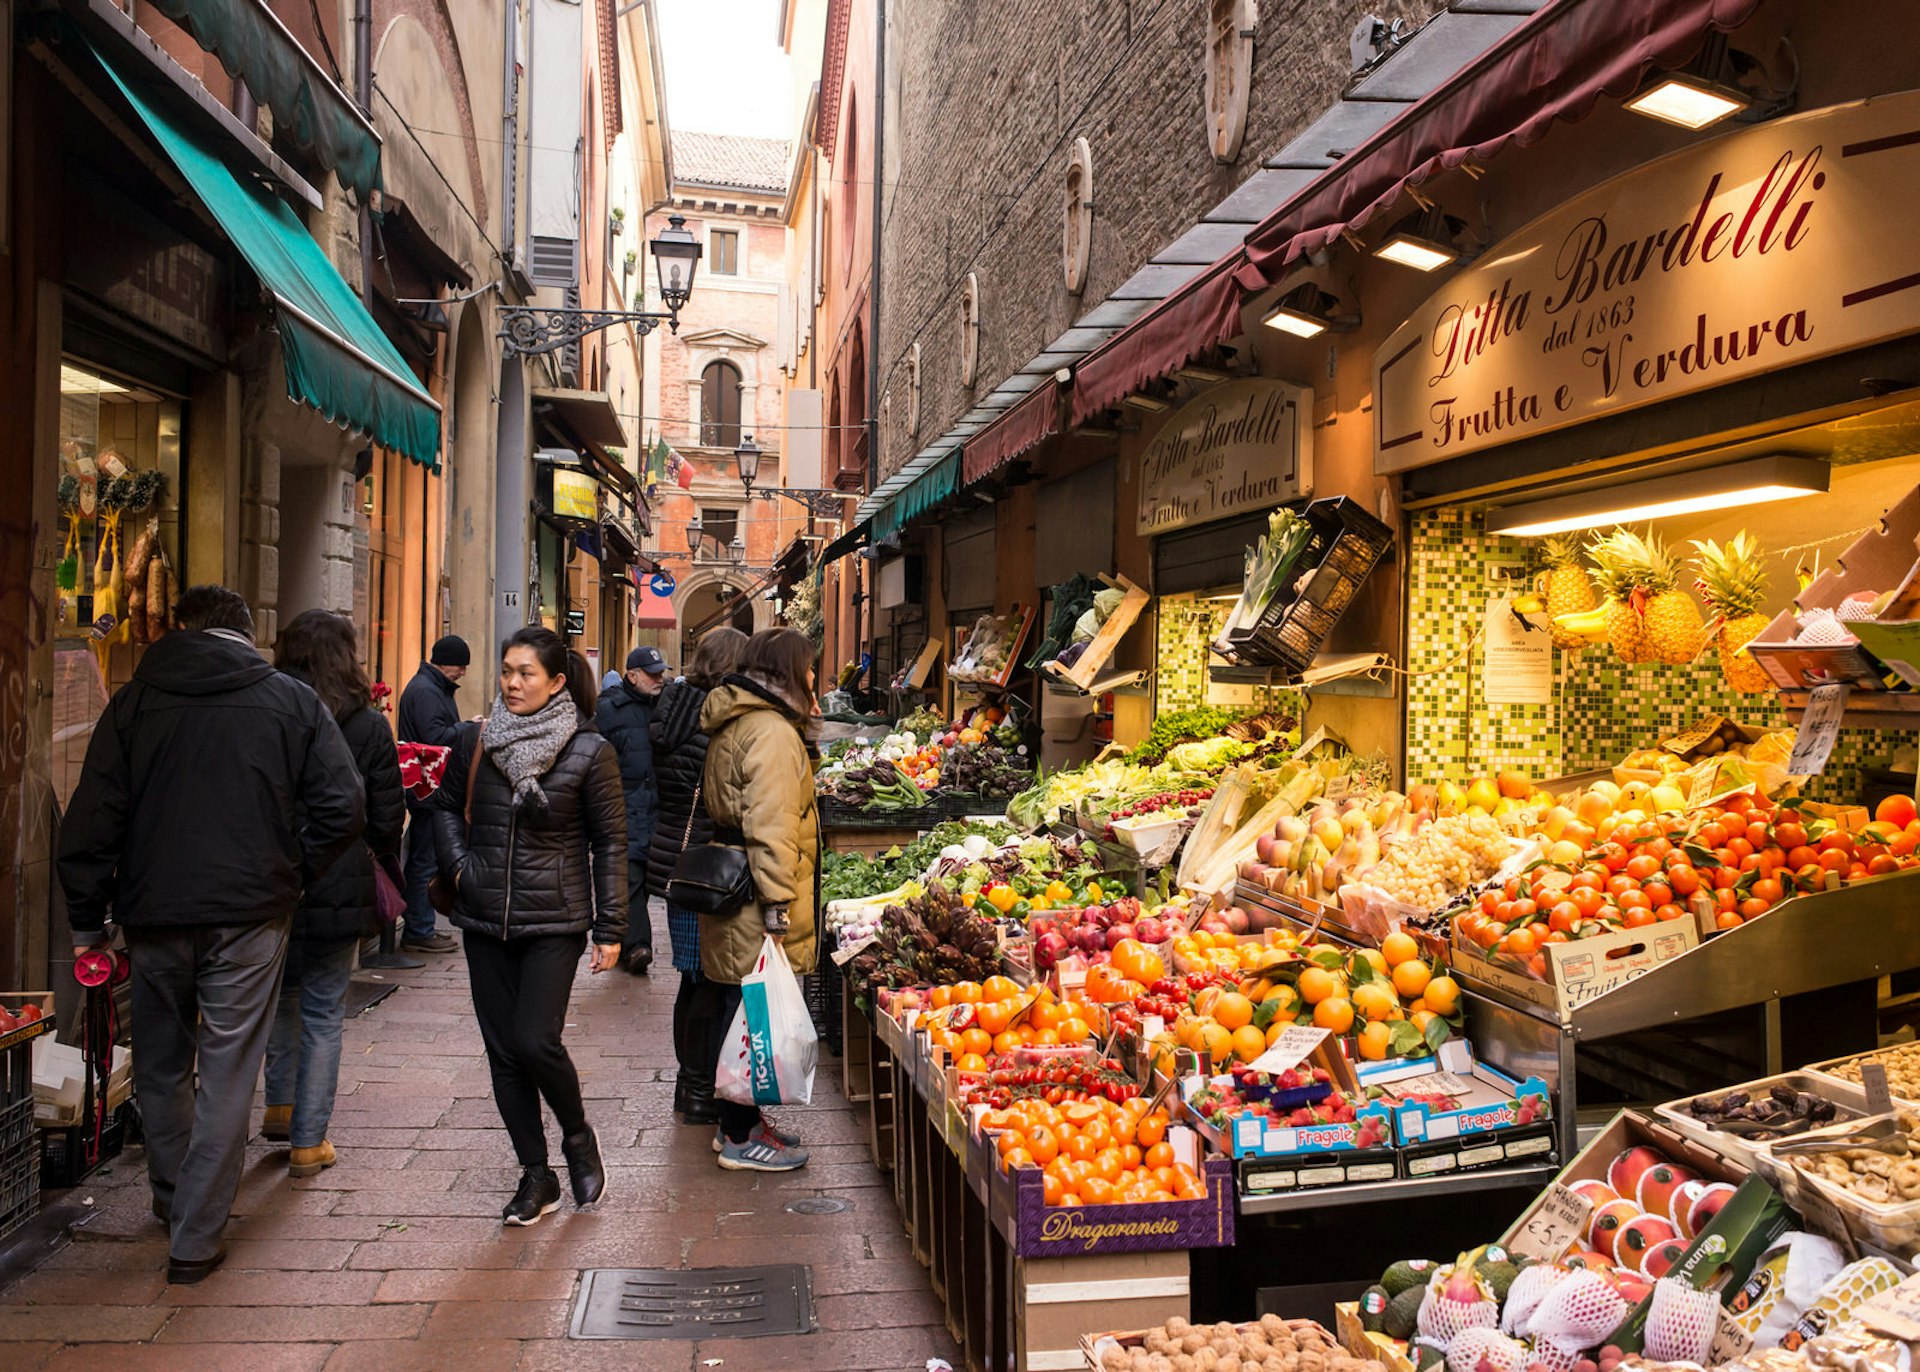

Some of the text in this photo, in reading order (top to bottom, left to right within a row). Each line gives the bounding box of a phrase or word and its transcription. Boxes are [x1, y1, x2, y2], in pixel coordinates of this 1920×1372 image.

[1428, 144, 1826, 388] Ditta Bardelli
[1543, 295, 1636, 355] dal 1863
[1429, 309, 1815, 448] Frutta e Verdura
[1150, 390, 1286, 489] Ditta Bardelli
[1148, 470, 1278, 527] Frutta e Verdura
[1566, 976, 1618, 1000] Fruit
[1298, 1127, 1353, 1148] Fragole
[1459, 1107, 1514, 1129] Fragole
[1040, 1211, 1179, 1250] Dragarancia
